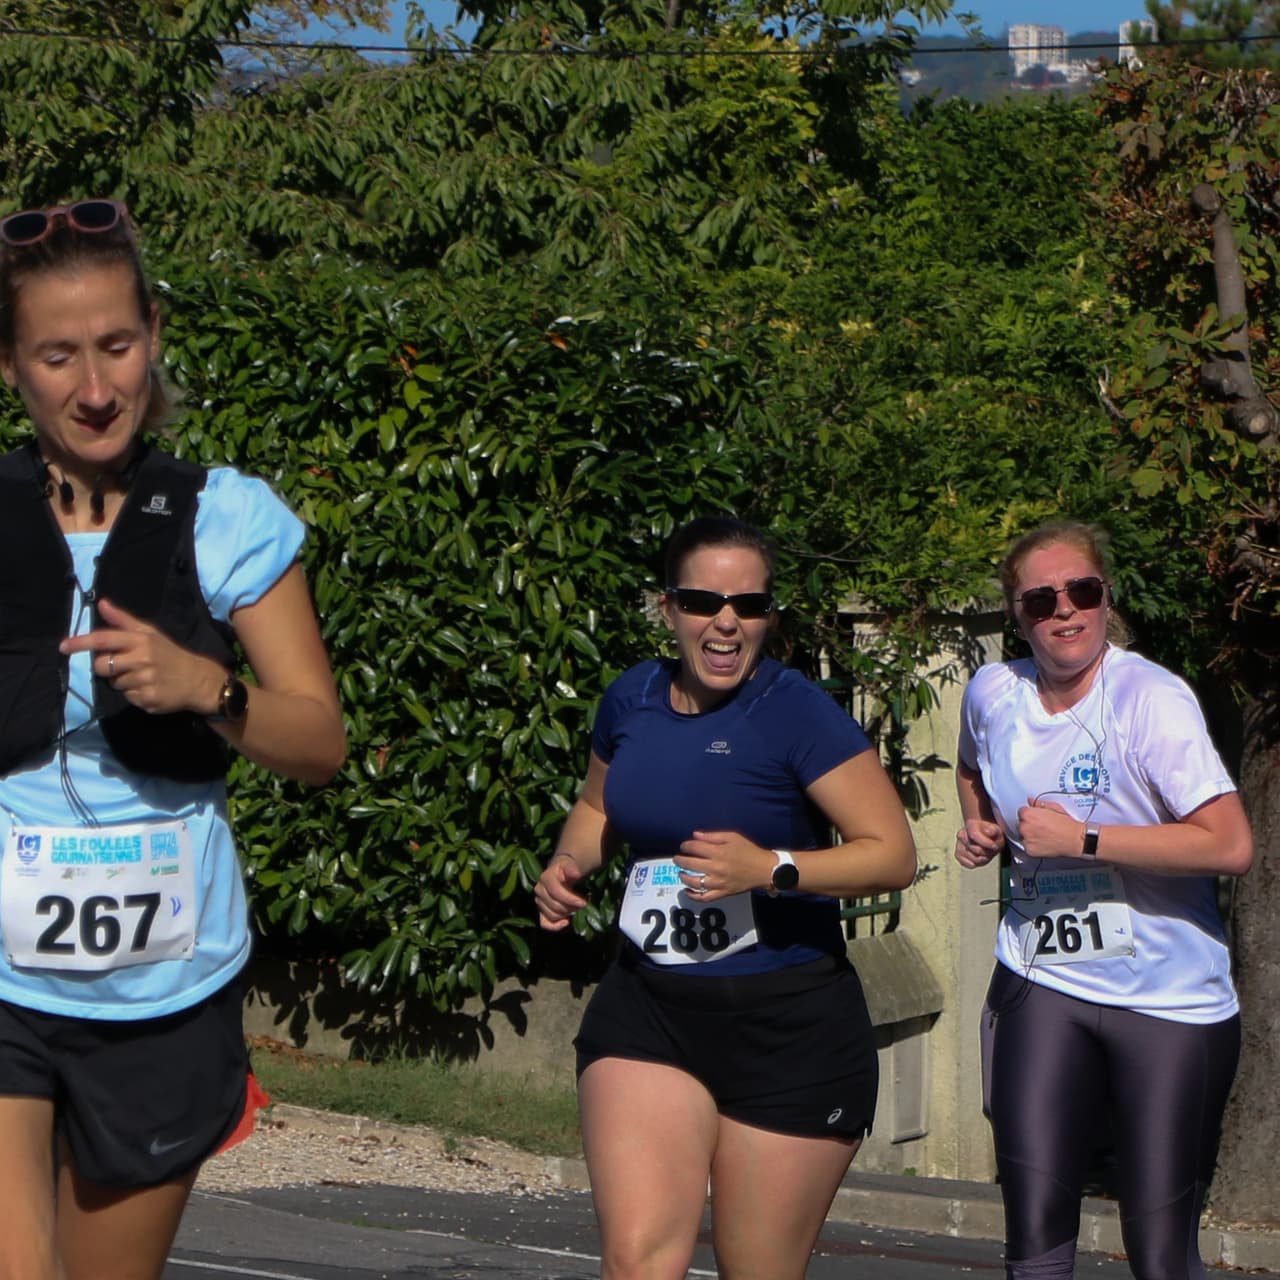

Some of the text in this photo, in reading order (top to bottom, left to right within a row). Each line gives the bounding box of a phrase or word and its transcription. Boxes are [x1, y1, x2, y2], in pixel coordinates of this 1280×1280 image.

[52, 836, 77, 851] LES
[79, 834, 142, 851] FOULEES
[35, 891, 161, 957] 267
[641, 907, 730, 954] 288
[1034, 911, 1105, 955] 261
